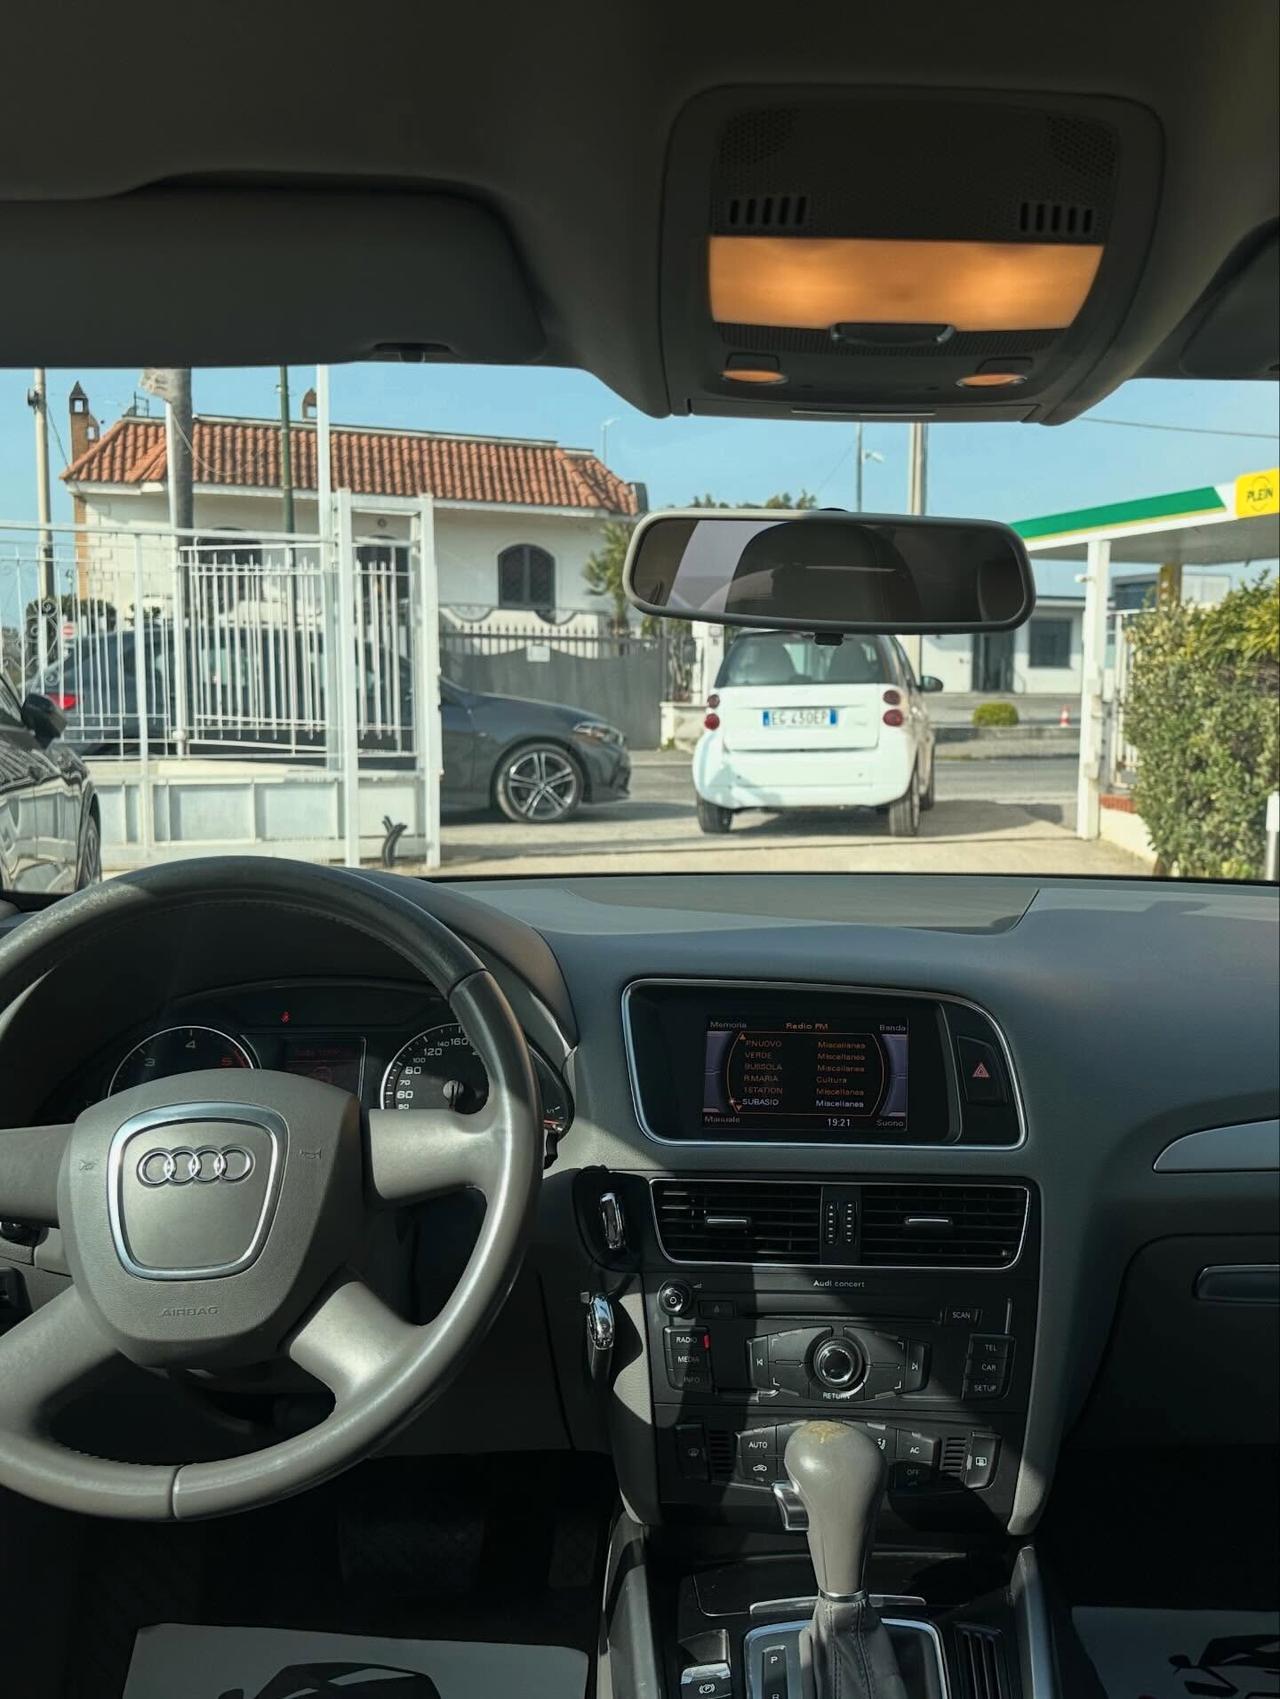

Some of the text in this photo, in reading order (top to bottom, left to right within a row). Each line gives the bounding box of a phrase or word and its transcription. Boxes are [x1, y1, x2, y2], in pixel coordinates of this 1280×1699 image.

[710, 1021, 747, 1029] Memoria
[785, 1022, 813, 1030] Radio
[879, 1024, 906, 1032] Banda
[185, 1040, 196, 1049] 4
[450, 1037, 469, 1046] 160
[817, 1041, 866, 1049] Miscellanea
[424, 1047, 443, 1056] 120
[745, 1051, 773, 1059] VERDE
[817, 1053, 865, 1061] Miscellanea
[144, 1058, 156, 1067] 3
[405, 1066, 422, 1075] 80
[816, 1076, 847, 1084] Cultura
[396, 1090, 414, 1099] 60
[816, 1088, 864, 1096] Miscellanea
[742, 1098, 779, 1106] SUBASIO
[816, 1100, 864, 1108] Miscellanea
[704, 1116, 740, 1124] Manuale
[827, 1118, 851, 1127] 19:21
[876, 1119, 904, 1127] Suono
[813, 1279, 833, 1287] Audi
[162, 1306, 219, 1317] AIRBAG
[952, 1311, 971, 1319] SCAN
[676, 1336, 698, 1344] RADIO
[984, 1344, 998, 1352] TEL
[981, 1363, 997, 1371] CAR
[974, 1384, 997, 1392] SETUP
[822, 1391, 850, 1399] RETURN
[748, 1441, 768, 1449] AUTO
[770, 1656, 778, 1664] P
